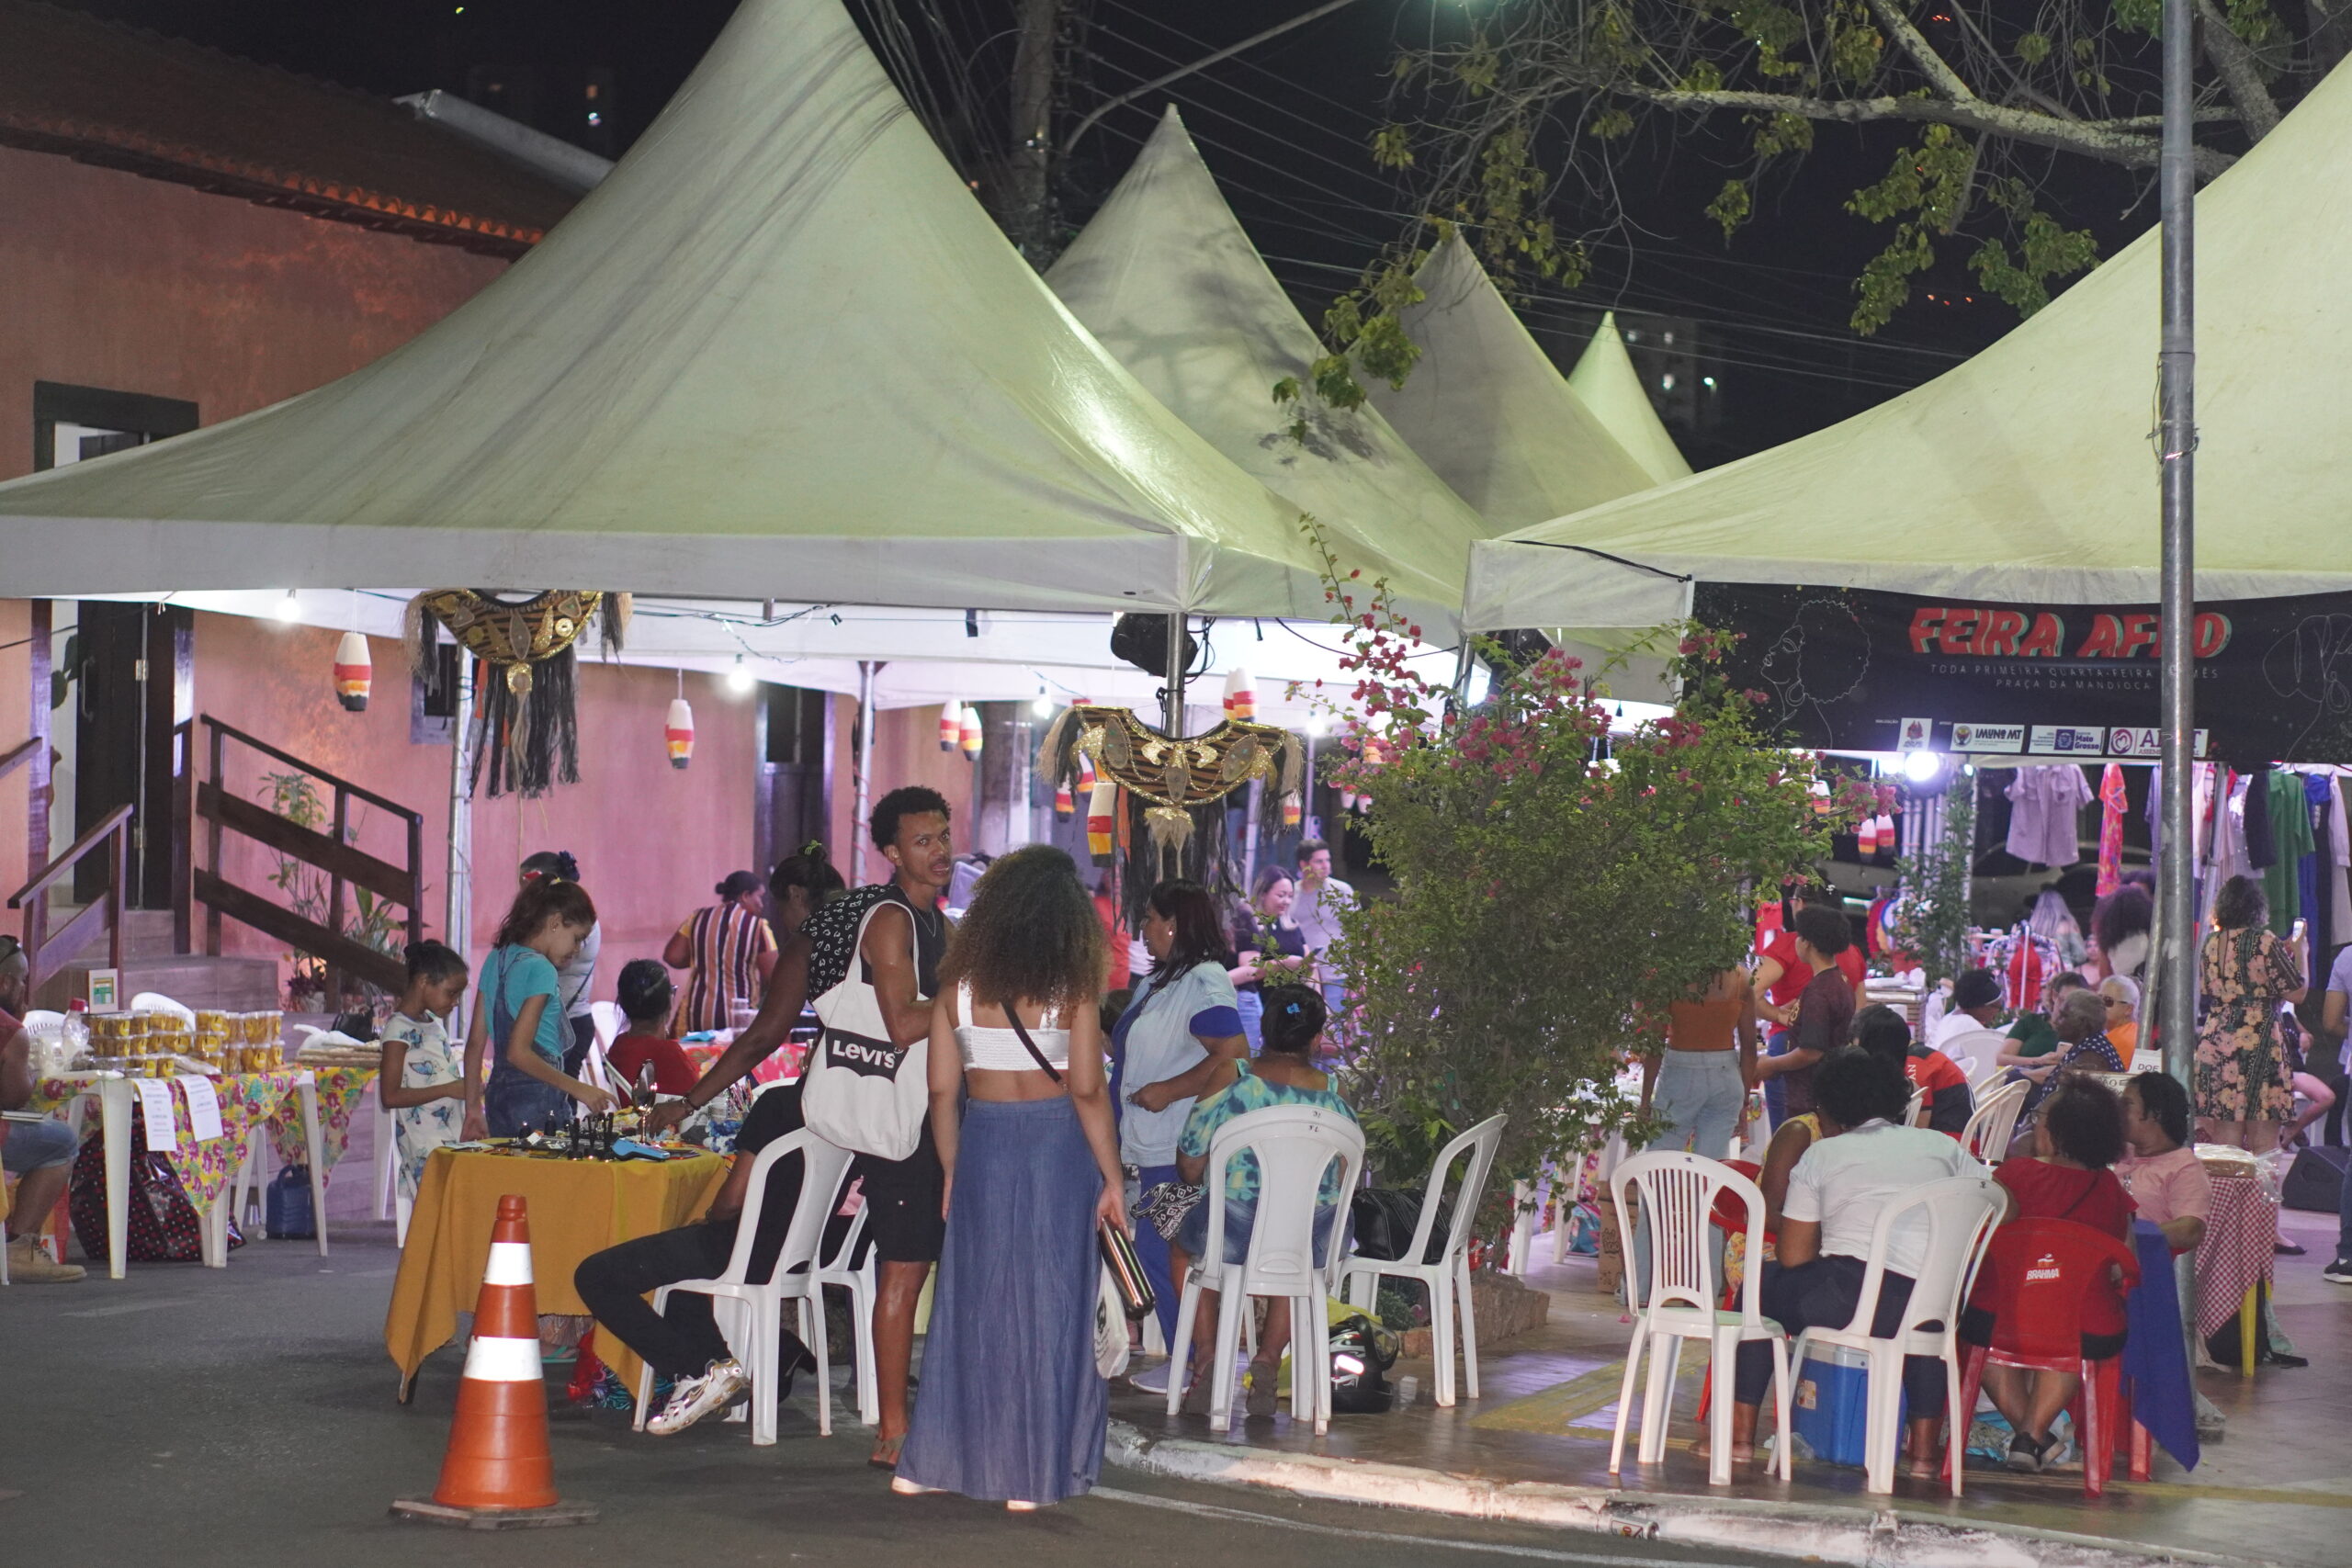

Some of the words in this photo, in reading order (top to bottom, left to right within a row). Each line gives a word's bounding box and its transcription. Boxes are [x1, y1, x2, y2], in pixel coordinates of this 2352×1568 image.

[1908, 607, 2064, 658] FEIRA
[2075, 613, 2233, 658] AFO
[1930, 664, 1967, 674] TODA
[1975, 666, 2041, 676] PRIMEIRA
[2049, 668, 2154, 678] QUARTA-FEIRA
[1996, 680, 2041, 690] PRAÇA
[2049, 681, 2066, 689] DA
[2075, 682, 2151, 691] MANDIOCA
[2007, 729, 2022, 739] MT
[2026, 1269, 2061, 1280] BRAHMA
